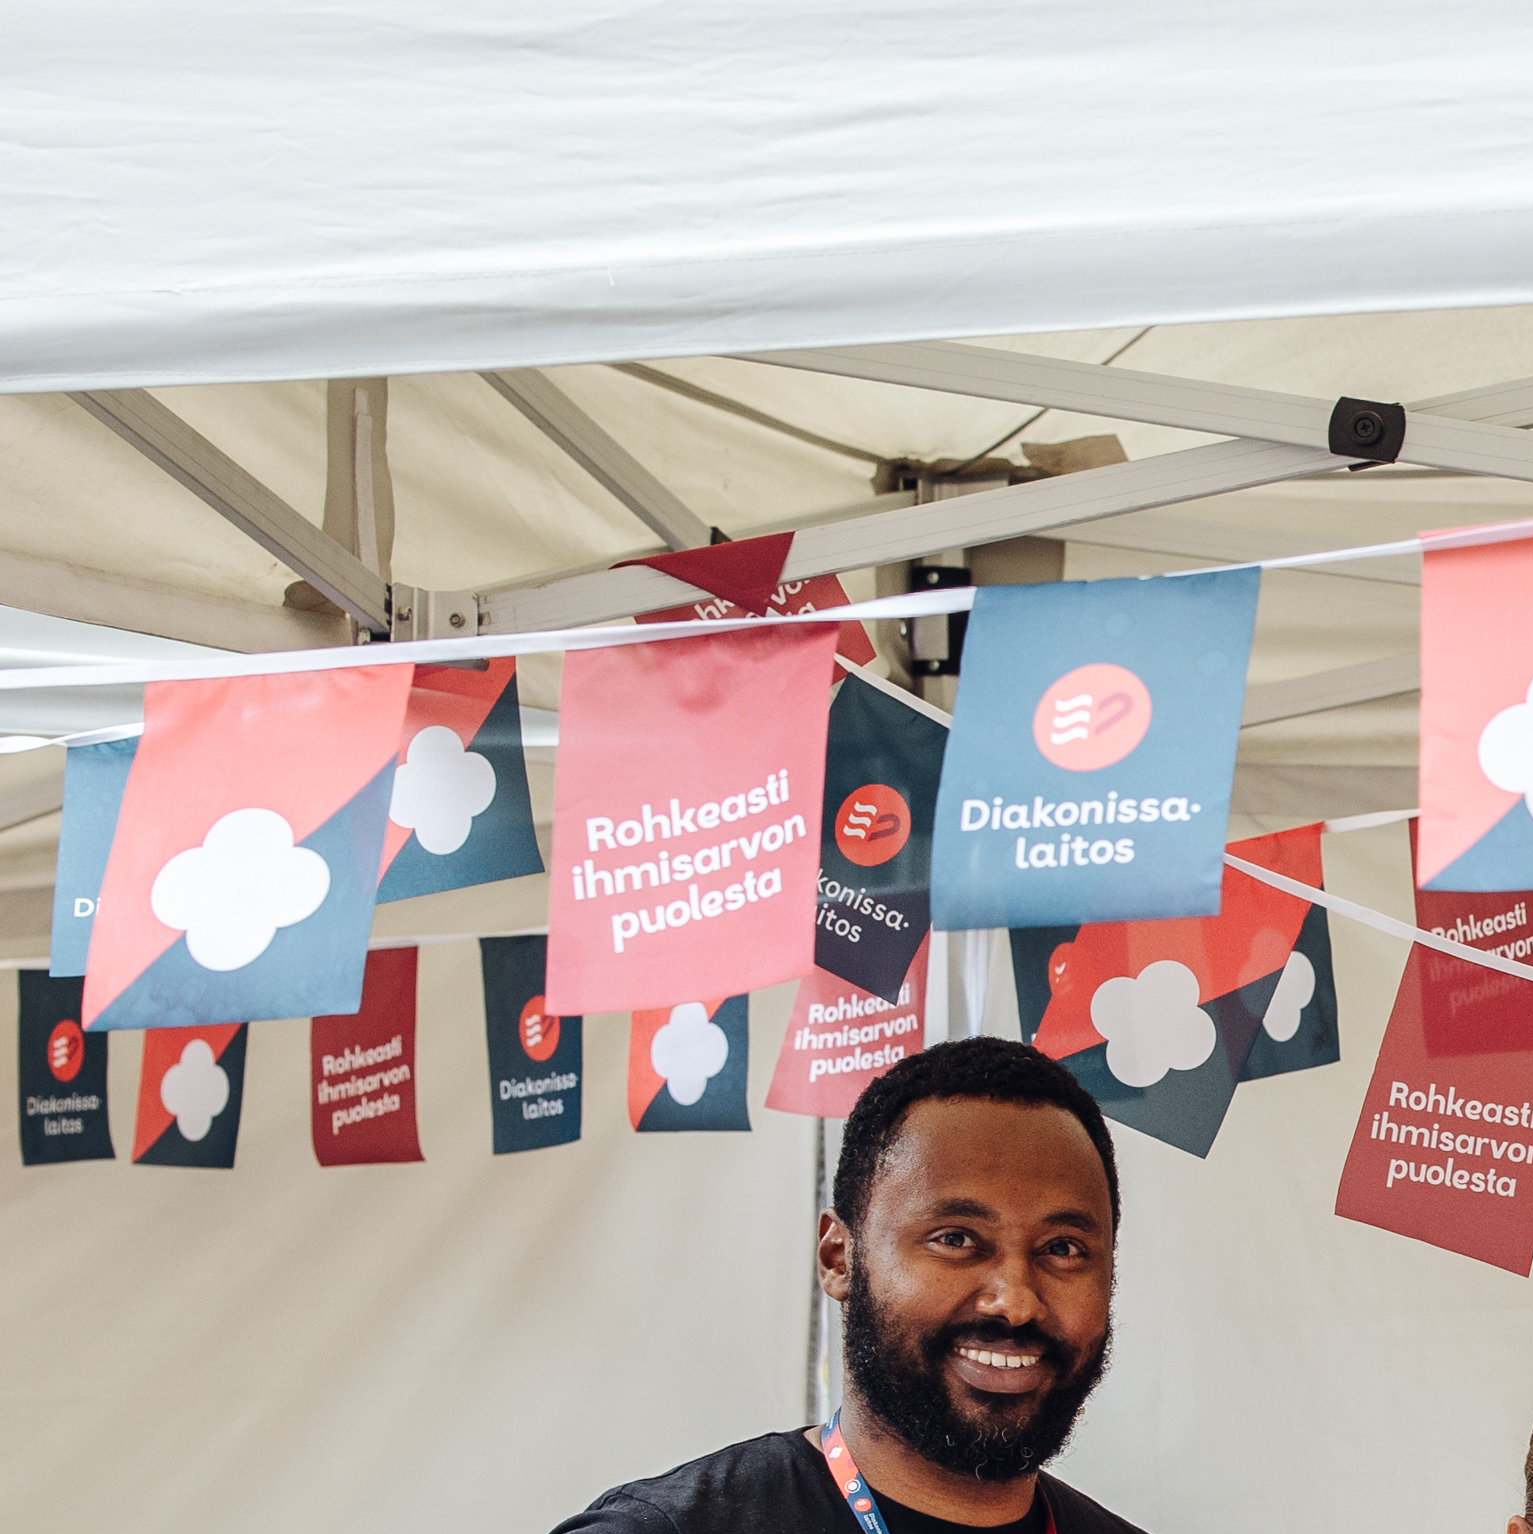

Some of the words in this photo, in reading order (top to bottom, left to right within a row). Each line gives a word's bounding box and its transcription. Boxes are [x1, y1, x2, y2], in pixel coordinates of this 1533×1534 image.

[586, 768, 791, 851] Rohkeasti
[572, 812, 806, 900] ihmisarvon
[1014, 828, 1136, 872] laitos
[610, 868, 782, 953] puolesta
[816, 903, 862, 942] itos
[794, 1013, 918, 1050] ihmisarvon
[321, 1034, 403, 1077] Rohkeasti
[809, 1044, 905, 1083] puolesta
[317, 1064, 411, 1106] ihmisarvon
[331, 1093, 400, 1136] puolesta
[522, 1098, 564, 1121] laitos
[1386, 1153, 1518, 1198] puolesta
